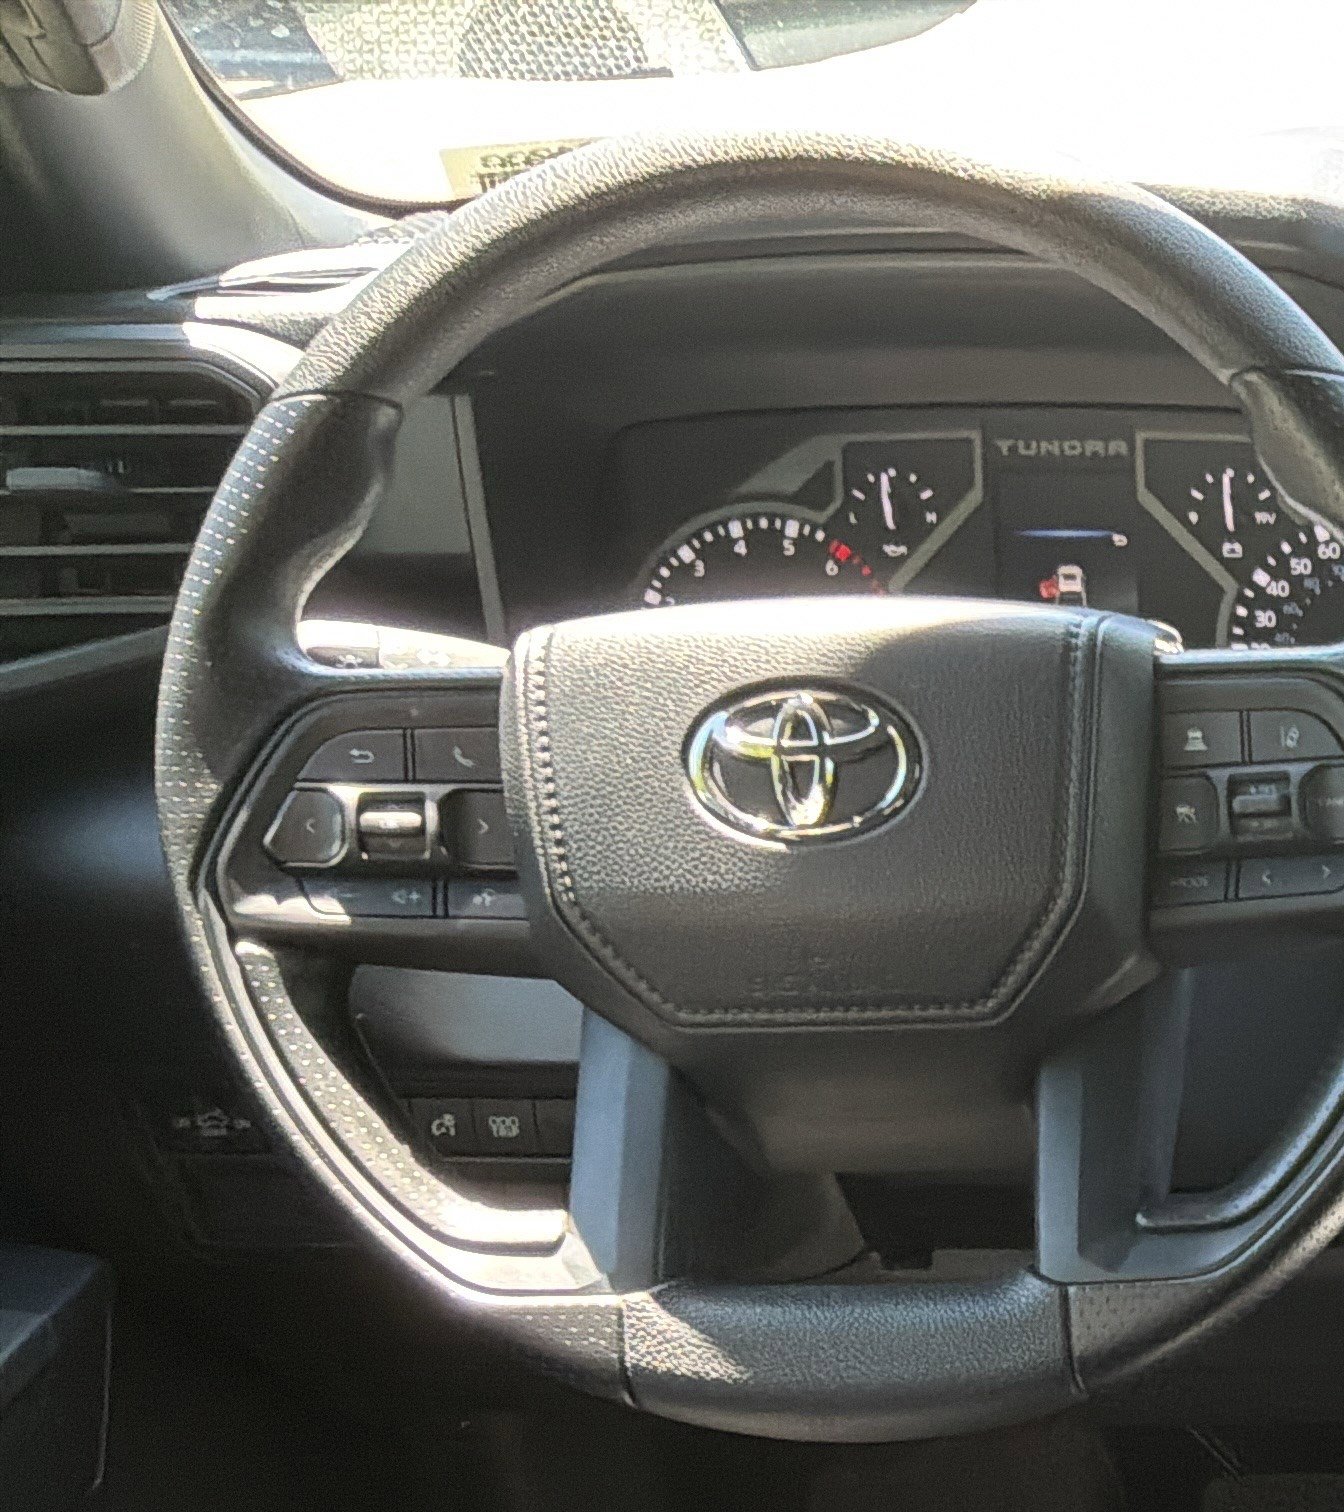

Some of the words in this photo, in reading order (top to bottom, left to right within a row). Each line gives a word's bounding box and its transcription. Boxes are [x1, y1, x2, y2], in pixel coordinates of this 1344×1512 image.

[994, 439, 1129, 457] TUNDRA
[733, 539, 747, 557] 4
[782, 539, 795, 556] 5
[1317, 542, 1341, 560] 60
[693, 559, 705, 577] 3
[825, 559, 839, 576] 6
[1290, 557, 1312, 576] 50
[1266, 579, 1290, 598] 40
[1254, 609, 1277, 628] 30
